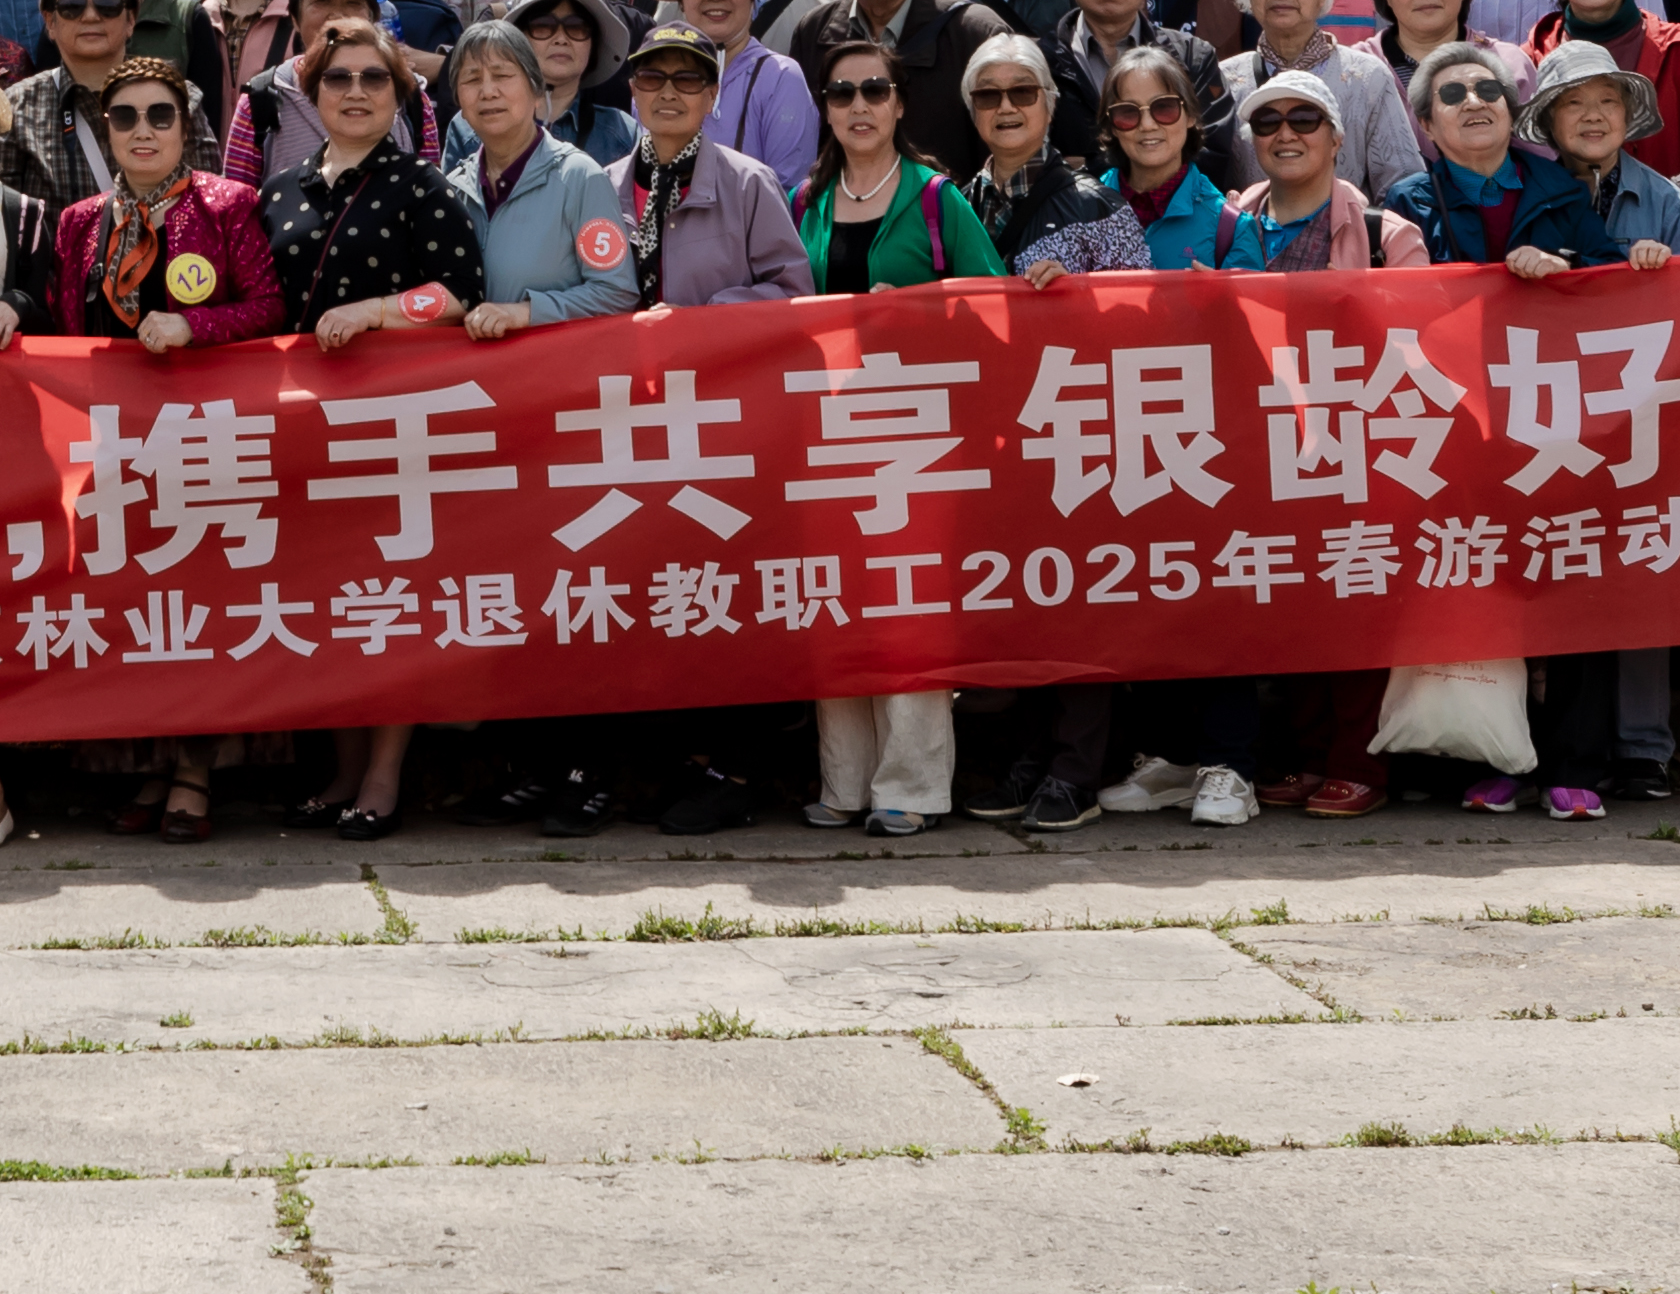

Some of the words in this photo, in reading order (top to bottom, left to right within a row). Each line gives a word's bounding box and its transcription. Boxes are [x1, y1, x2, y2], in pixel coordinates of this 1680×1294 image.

[593, 231, 611, 257] 5
[177, 263, 209, 292] 12
[412, 294, 436, 311] 4
